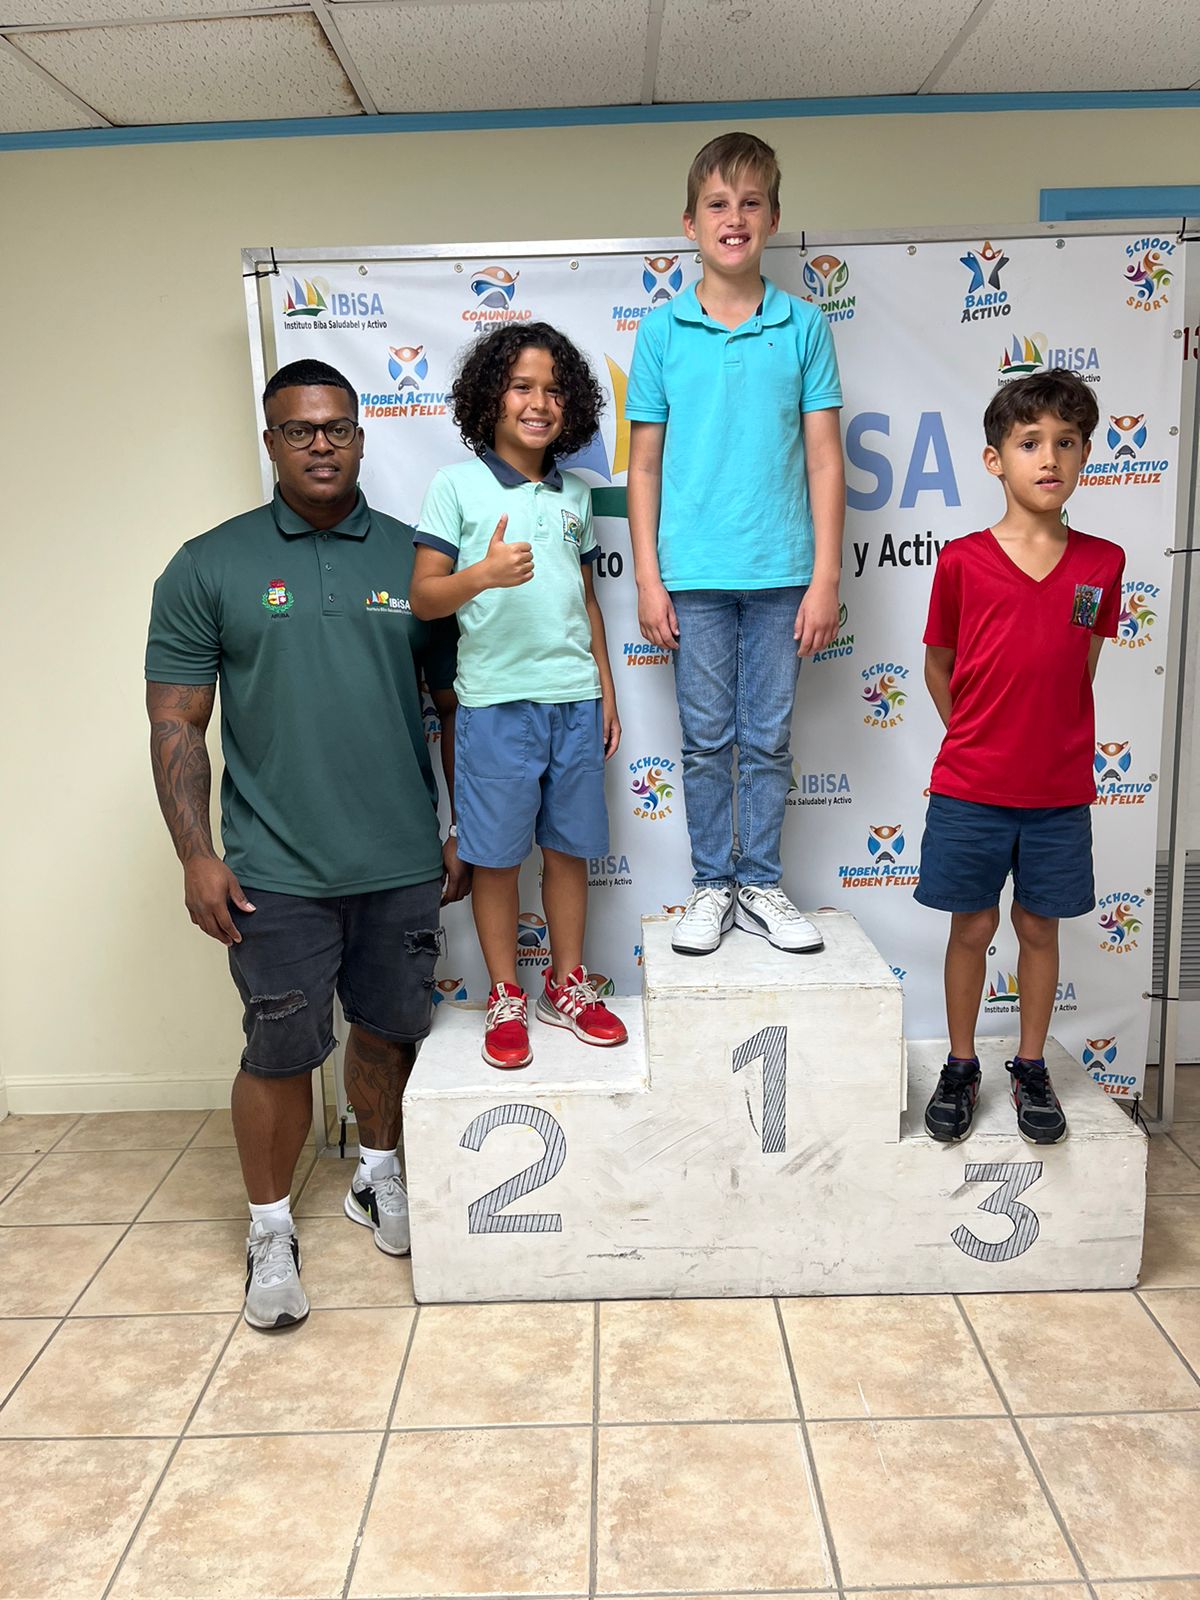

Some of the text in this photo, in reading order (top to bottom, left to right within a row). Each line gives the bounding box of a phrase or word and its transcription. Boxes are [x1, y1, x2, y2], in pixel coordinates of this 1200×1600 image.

[1126, 238, 1176, 258] SCHOOL
[332, 293, 384, 316] IBiSA
[819, 296, 856, 312] DINAN
[965, 291, 1008, 308] BARIO
[1126, 294, 1168, 311] SPORT
[462, 310, 532, 321] COMUNIDAD
[826, 309, 854, 323] TIVO
[961, 304, 1011, 323] ACTIVO
[284, 320, 388, 331] Instituto Biba Saludabel y Activo
[1048, 348, 1100, 370] IBiSA
[360, 393, 403, 406] HOBEN
[364, 404, 447, 418] HOBEN FELIZ
[1081, 460, 1169, 474] OBEN ACTIVO
[1079, 472, 1162, 487] HOBEN FELIZ
[853, 531, 950, 578] y Activ
[1121, 581, 1160, 598] HOOL
[389, 598, 411, 610] IBiSA
[1111, 633, 1152, 649] SPORT
[627, 655, 669, 666] HOBEN
[813, 646, 853, 663] ACTIVO
[861, 663, 909, 680] SCHOOL
[864, 713, 904, 729] SPORT
[629, 756, 676, 774] SCHOOL
[802, 773, 850, 794] IBiSA
[1107, 783, 1152, 794] ACTIVO
[798, 797, 827, 805] Saludabel
[833, 796, 853, 804] Activo
[1110, 794, 1145, 805] FELIZ
[633, 805, 673, 821] SPORT
[589, 856, 630, 875] BiSA
[839, 866, 880, 877] HOBEN
[614, 878, 633, 886] Activo
[842, 875, 920, 888] HOBEN FELIZ
[1098, 892, 1145, 909] SCHOOL
[1100, 940, 1139, 954] SPORT
[518, 957, 550, 967] CTIVO
[1093, 1072, 1136, 1085] ACTIVO
[732, 1025, 787, 1153] 1
[459, 1104, 567, 1234] 2
[950, 1161, 1043, 1263] 3
